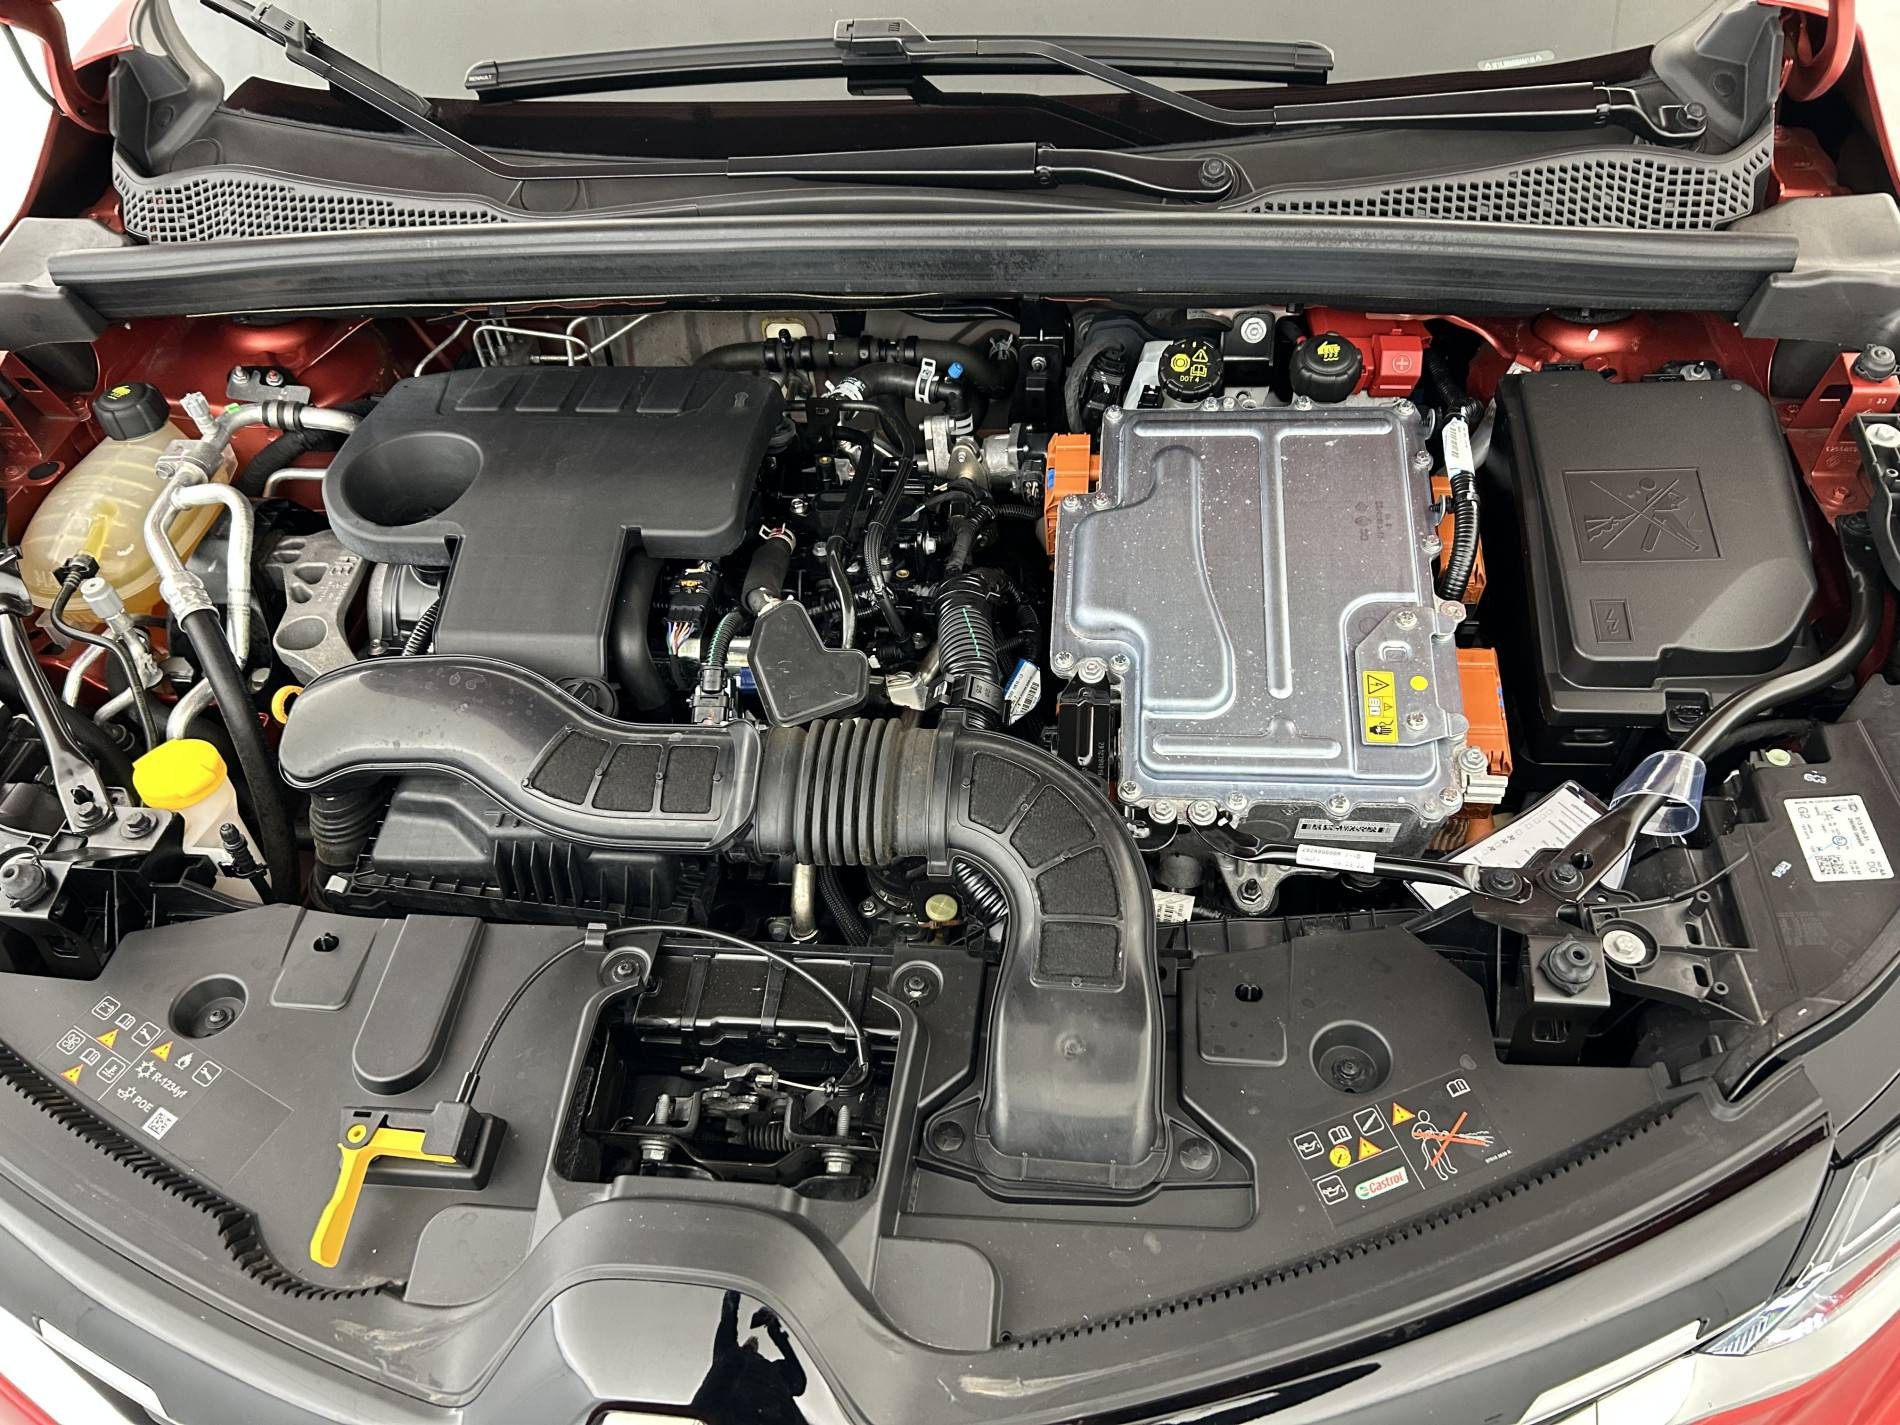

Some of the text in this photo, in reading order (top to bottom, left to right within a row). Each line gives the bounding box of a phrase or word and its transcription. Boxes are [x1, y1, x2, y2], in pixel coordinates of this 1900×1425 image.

[151, 1071, 188, 1098] R-1234yf
[132, 1095, 154, 1113] POE
[1368, 1171, 1405, 1194] Castrol
